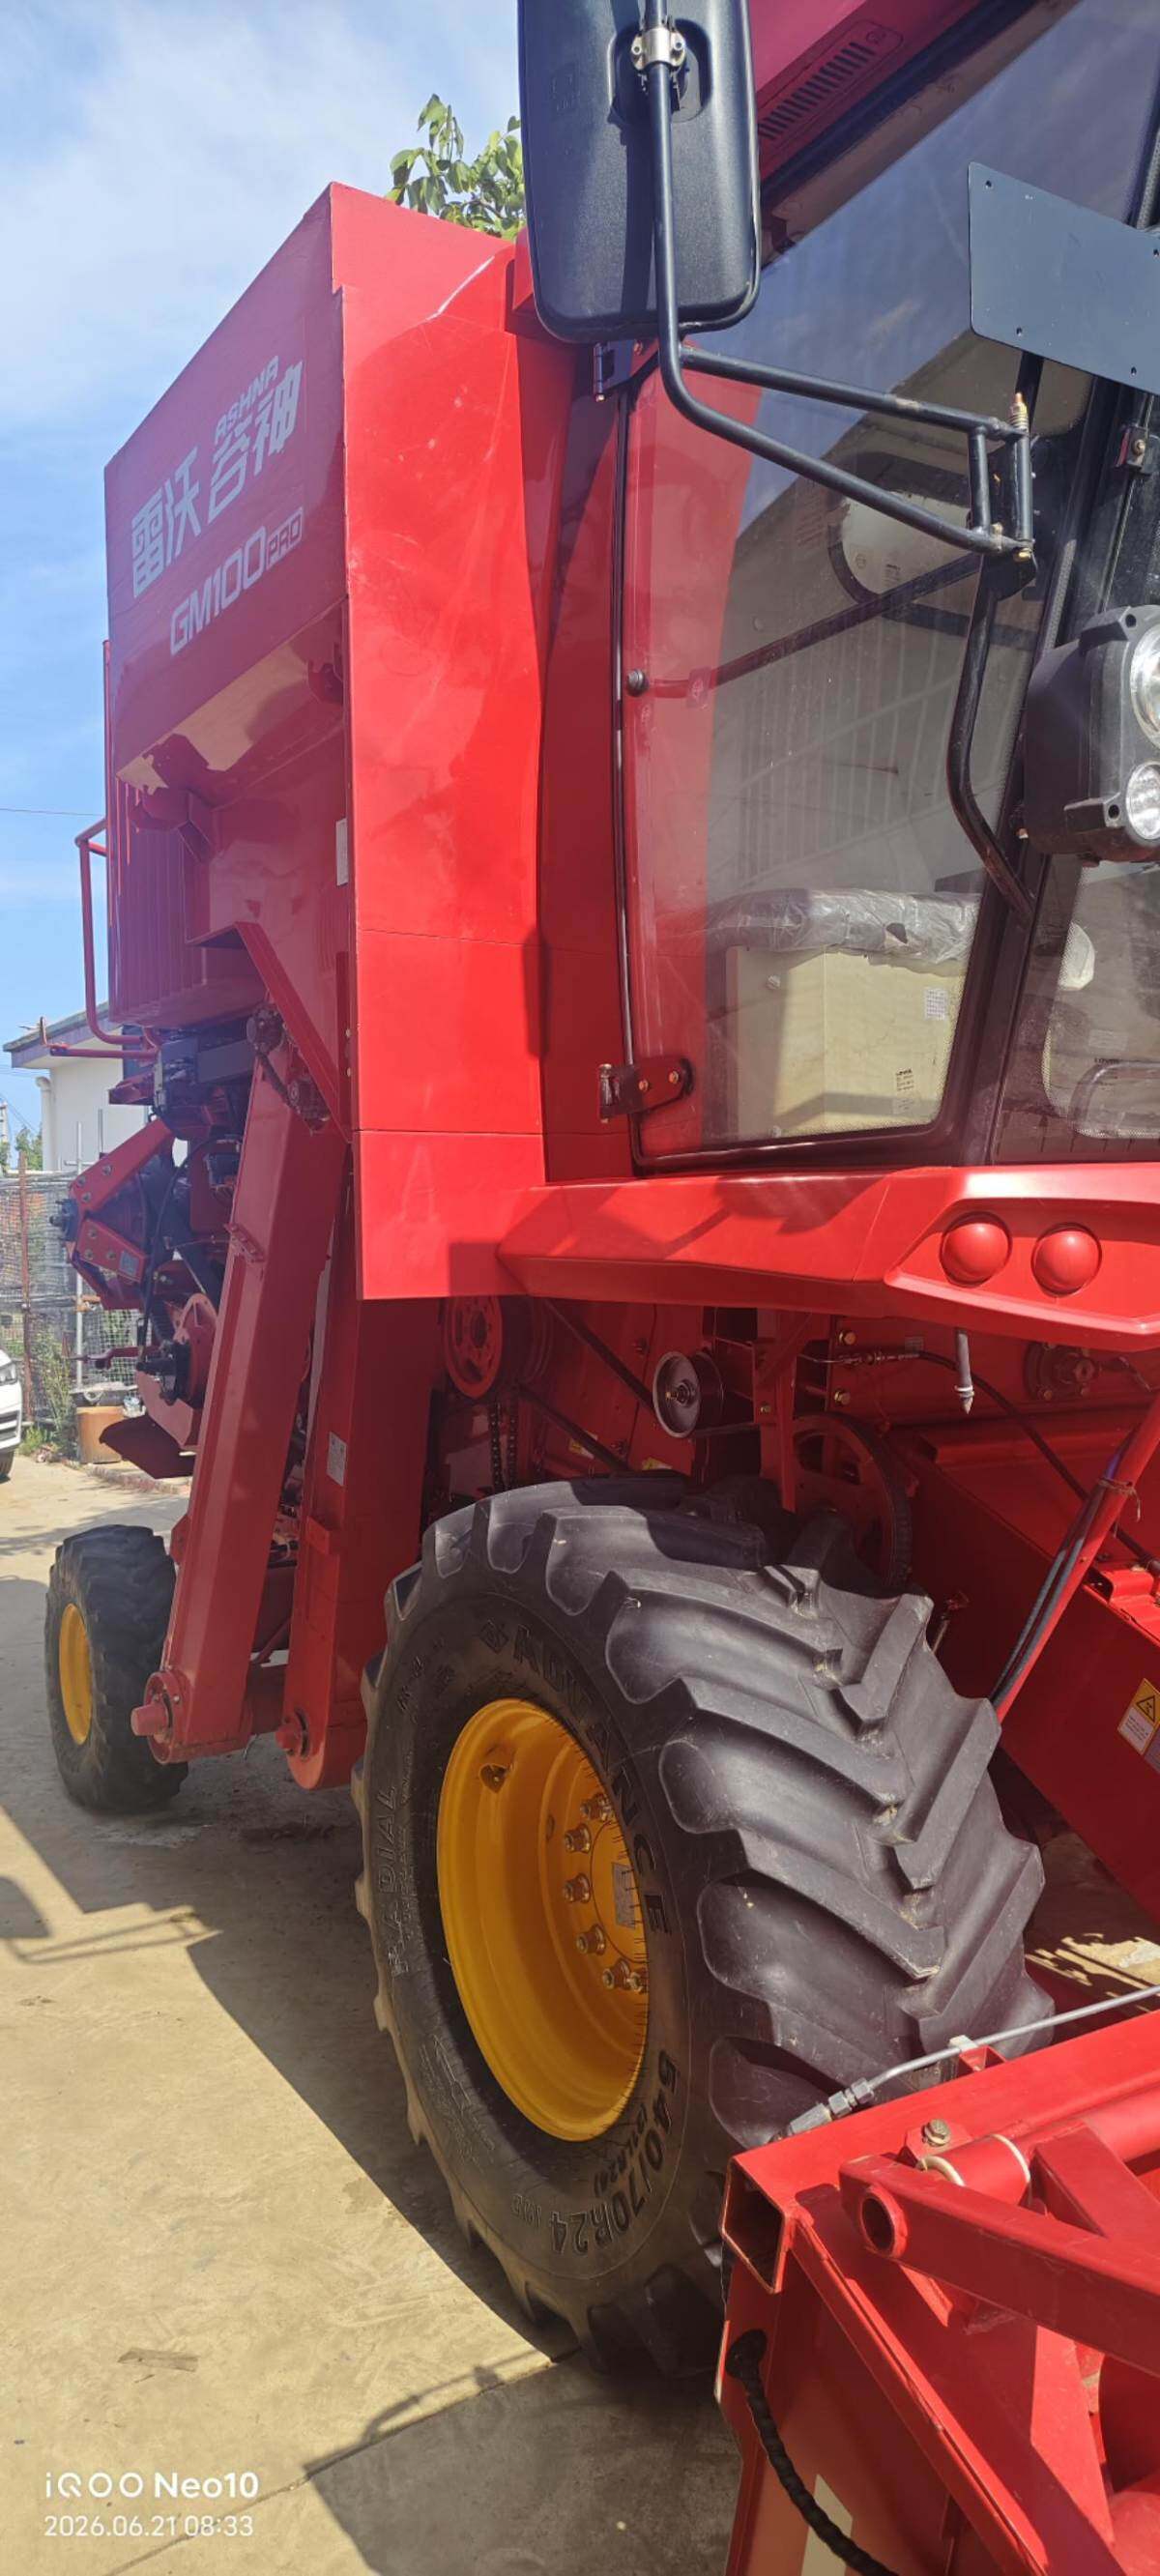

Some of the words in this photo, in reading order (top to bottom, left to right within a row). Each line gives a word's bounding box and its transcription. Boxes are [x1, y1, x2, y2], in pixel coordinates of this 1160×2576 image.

[131, 361, 304, 599] 雷沃谷神
[170, 525, 266, 656] GM100
[267, 508, 303, 568] PRO
[550, 2049, 681, 2256] 540/70R24
